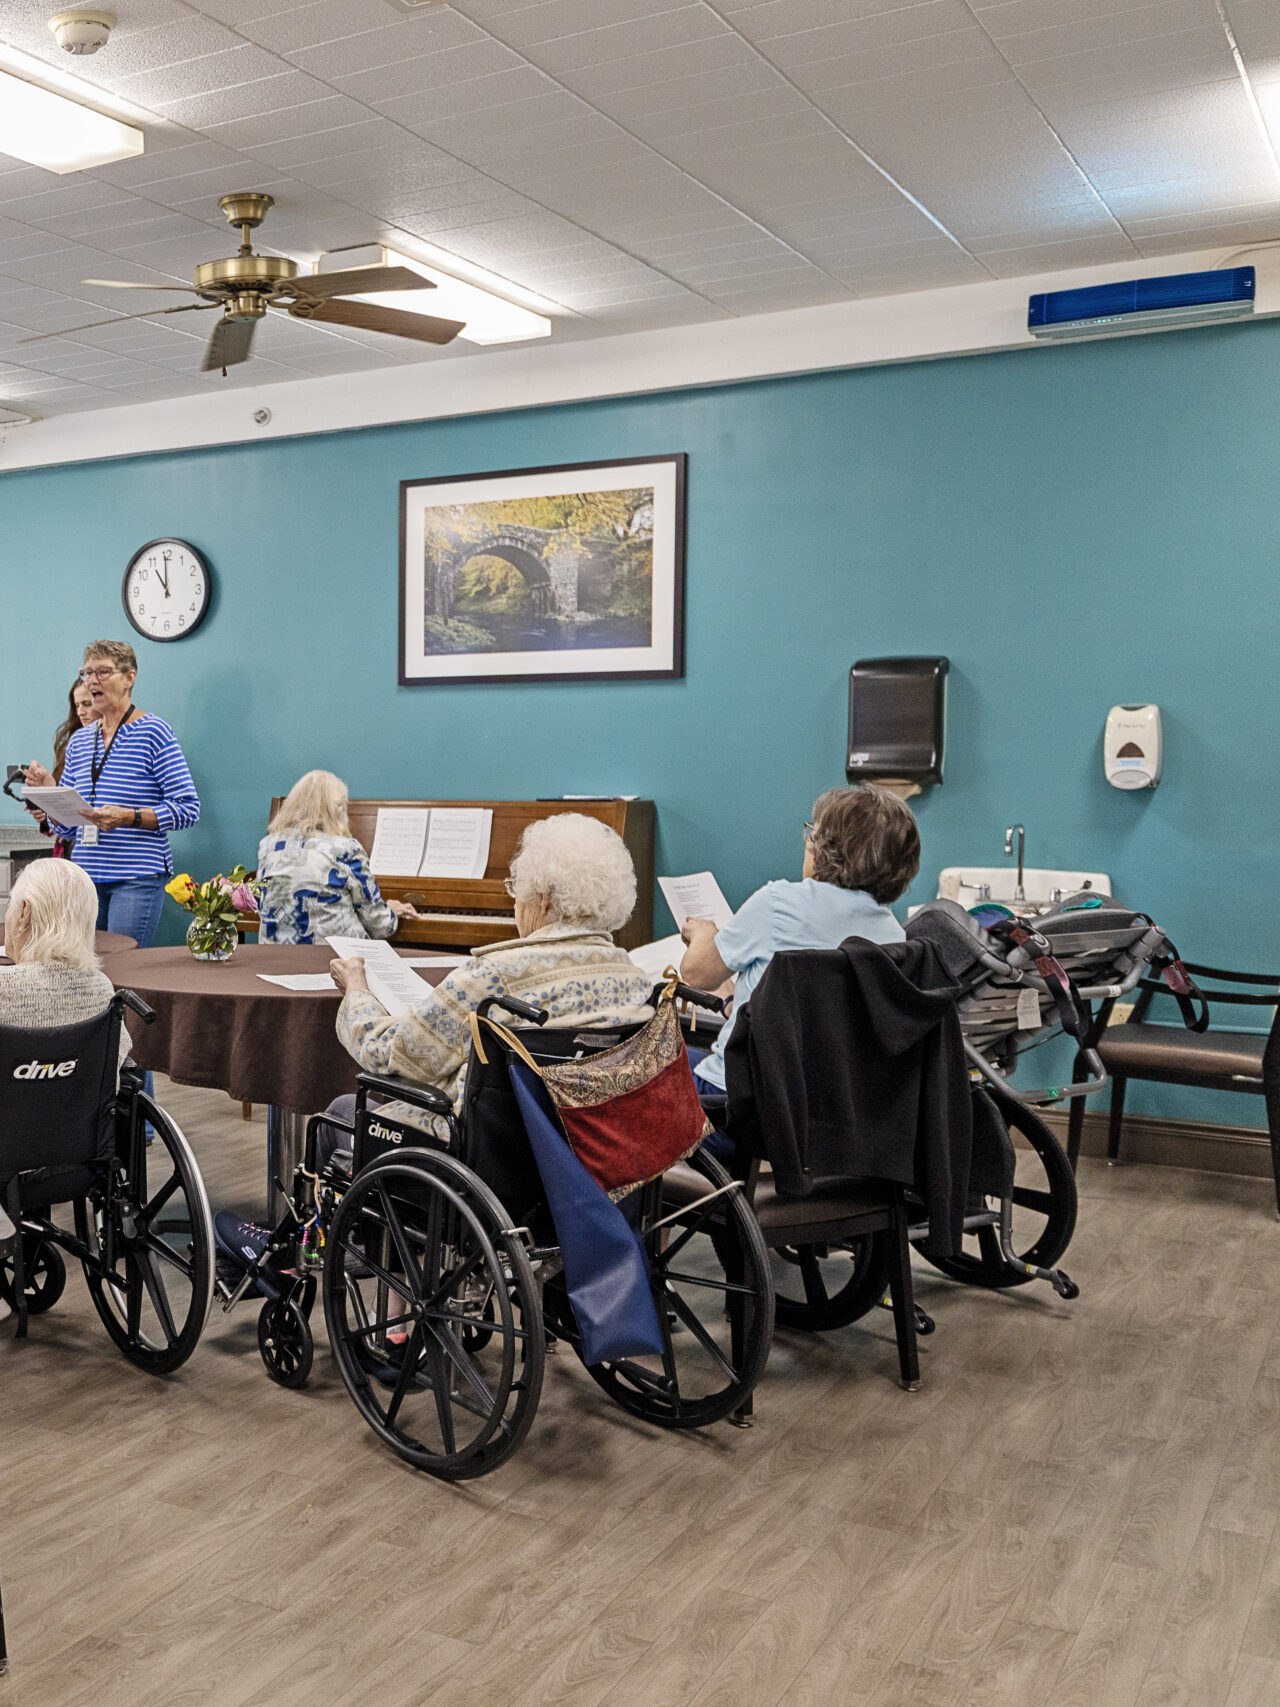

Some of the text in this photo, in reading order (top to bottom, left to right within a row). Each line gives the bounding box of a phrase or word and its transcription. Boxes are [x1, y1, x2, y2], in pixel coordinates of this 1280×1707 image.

[162, 549, 173, 561] 12
[148, 557, 157, 568] 11
[138, 569, 149, 581] 10
[190, 565, 197, 577] 2
[133, 586, 140, 598] 9
[195, 583, 202, 596] 3
[138, 604, 145, 615] 8
[189, 602, 196, 613] 4
[150, 616, 157, 627] 7
[163, 620, 170, 631] 6
[178, 614, 185, 626] 5
[13, 1060, 76, 1079] drive
[368, 1122, 404, 1144] drive
